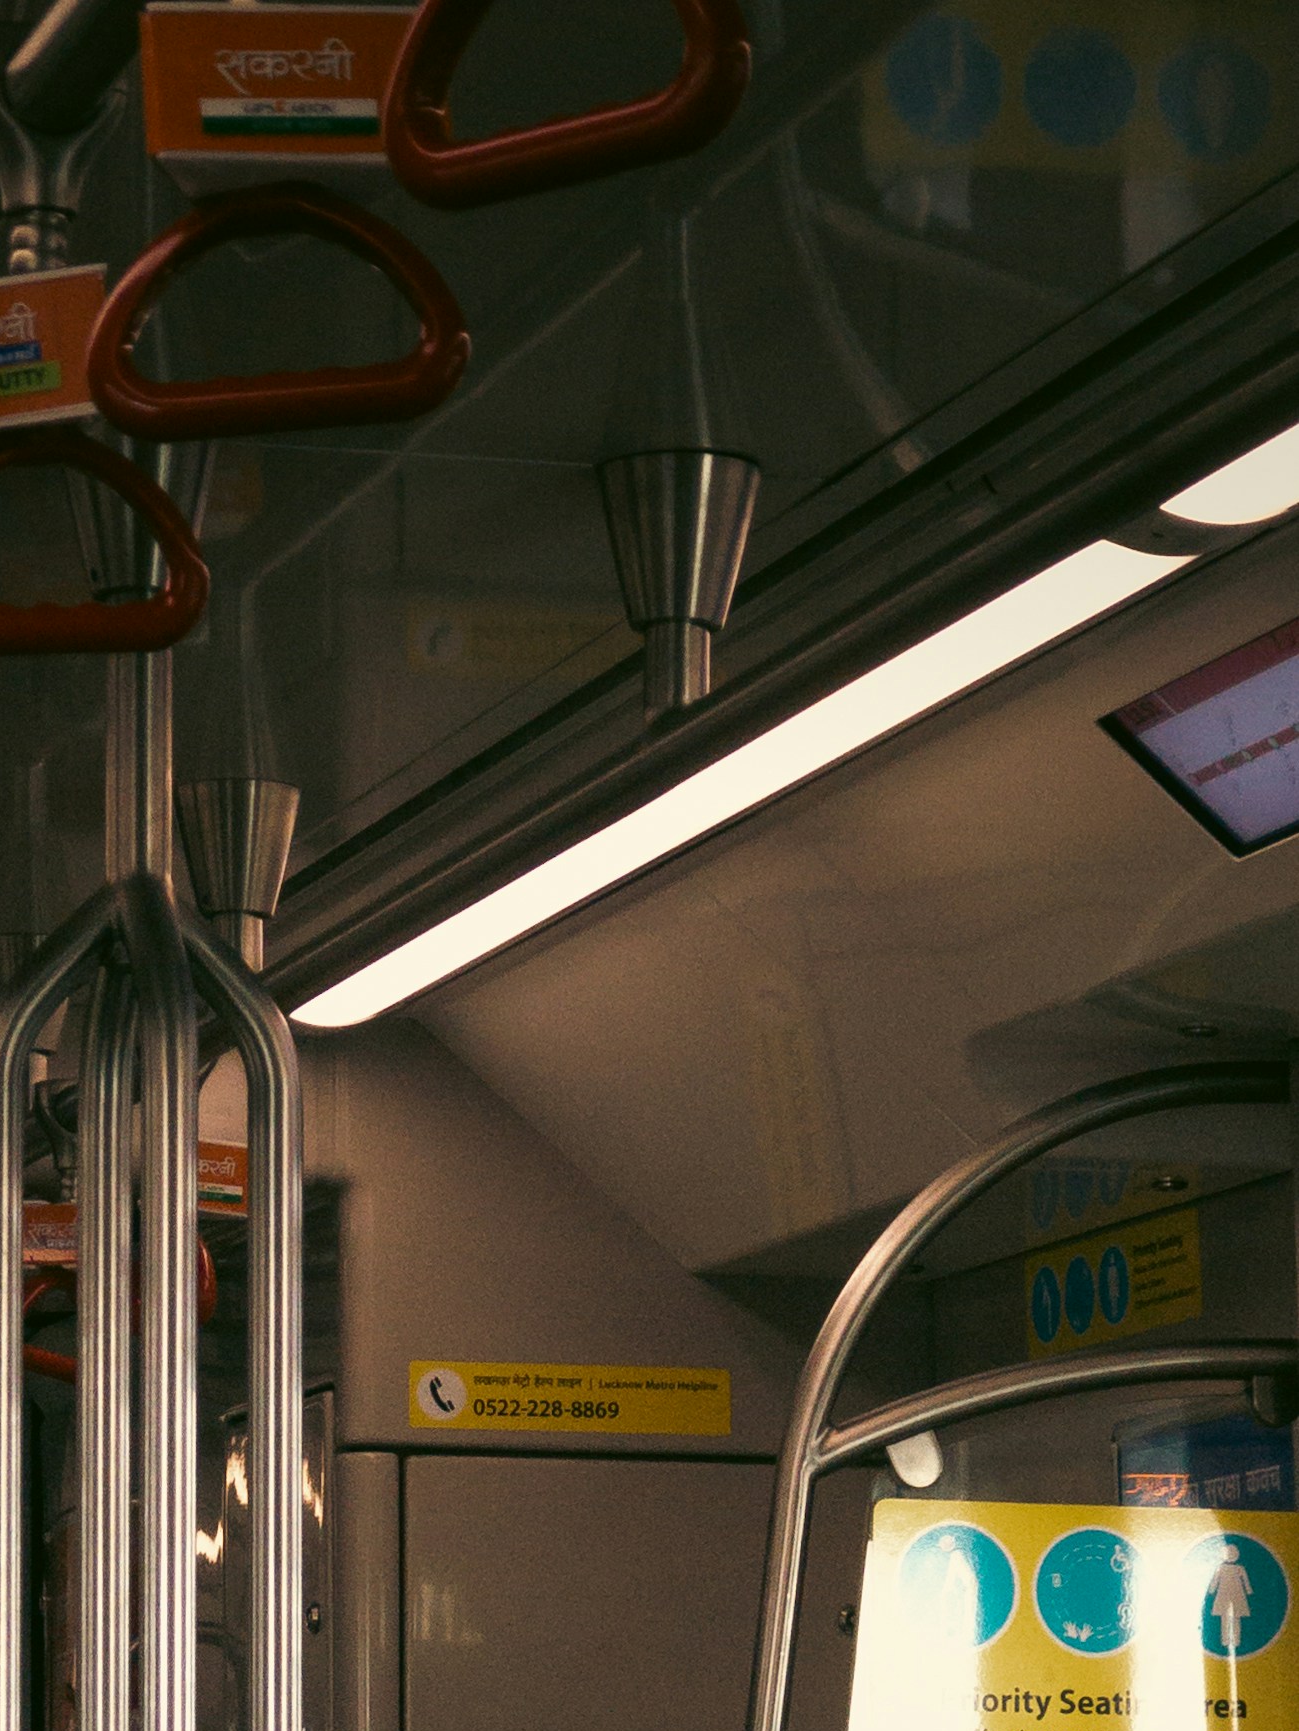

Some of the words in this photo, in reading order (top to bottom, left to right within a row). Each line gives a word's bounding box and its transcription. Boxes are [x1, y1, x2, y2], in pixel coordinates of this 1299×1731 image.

[645, 1380, 675, 1390] Metro
[677, 1381, 719, 1392] Helpline
[473, 1398, 620, 1418] 0522-228-8869
[1059, 1688, 1133, 1717] Seati
[1204, 1697, 1247, 1719] rea
